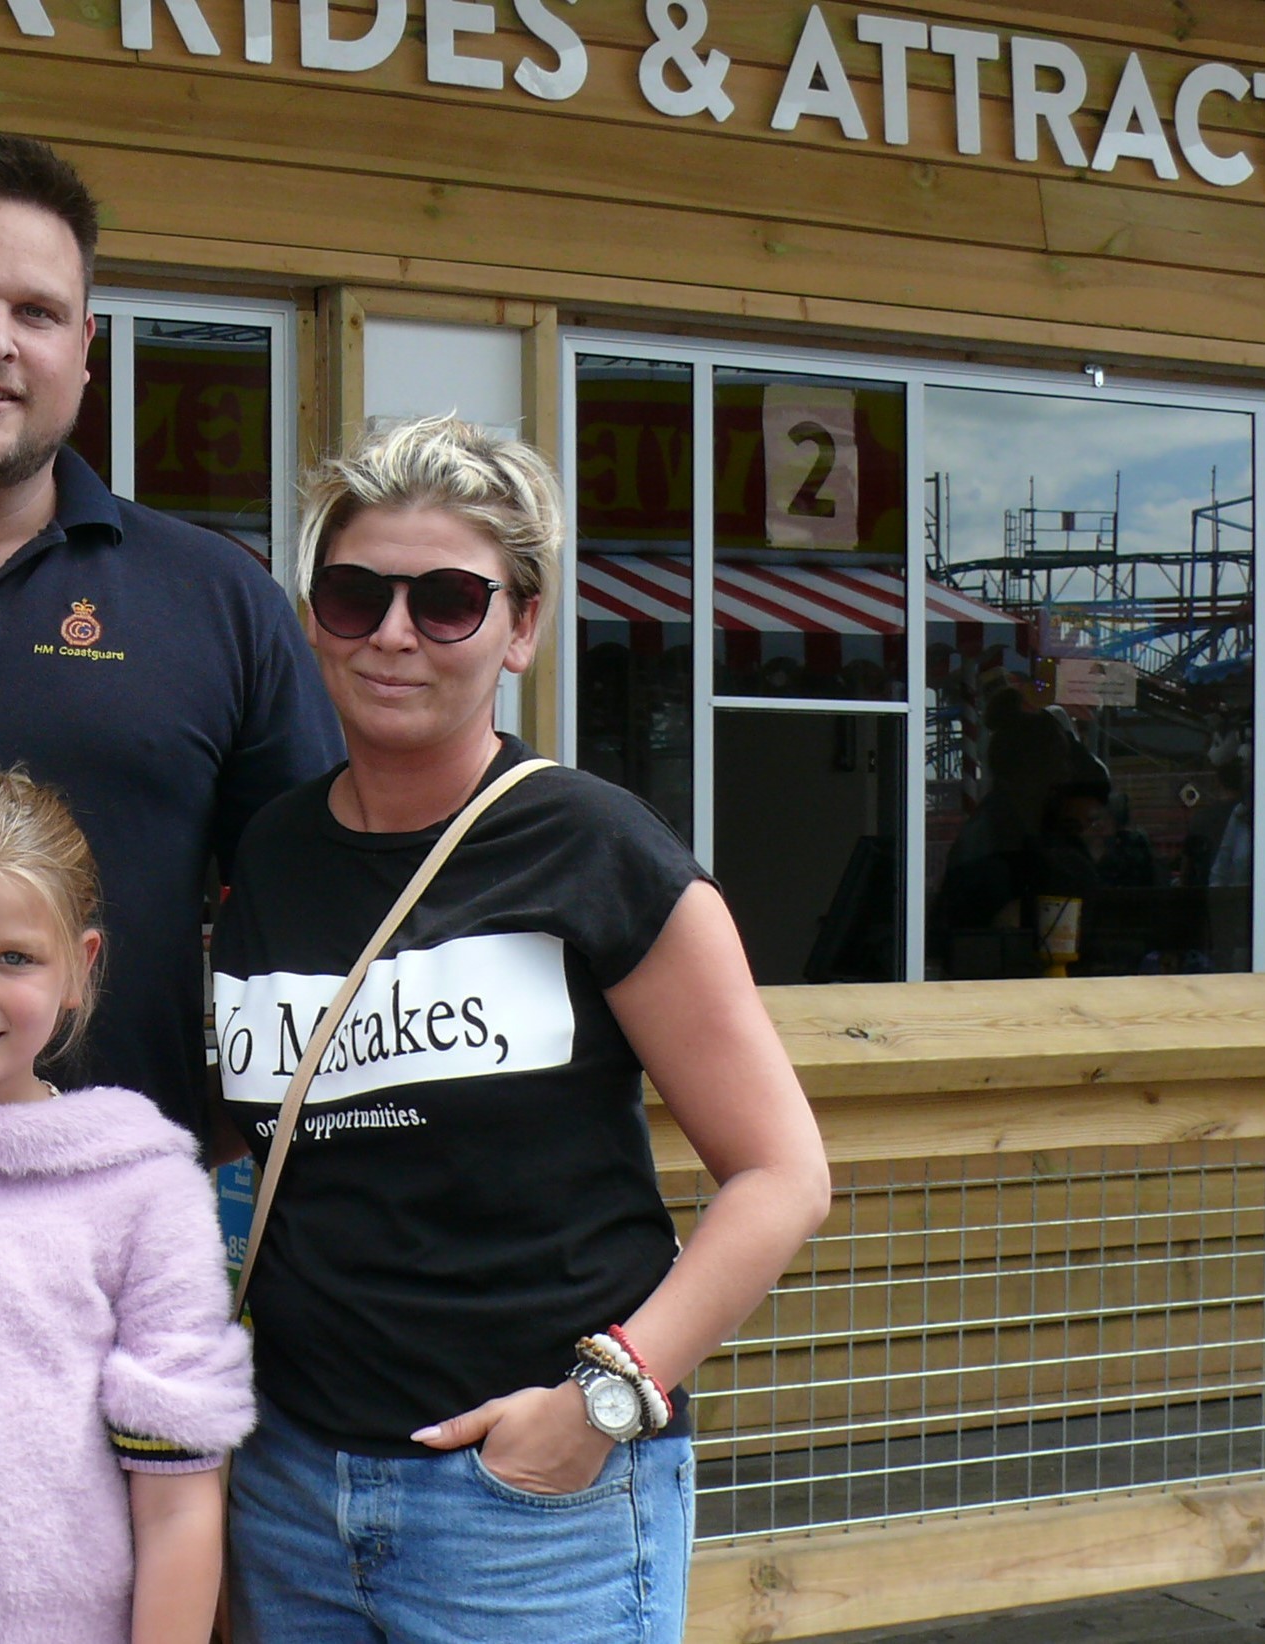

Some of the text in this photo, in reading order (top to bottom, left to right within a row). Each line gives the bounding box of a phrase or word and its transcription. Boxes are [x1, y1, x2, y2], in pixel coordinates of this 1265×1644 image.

[638, 0, 735, 123] &
[770, 4, 1265, 188] ATTRAC
[788, 420, 837, 518] 2
[34, 644, 124, 660] HM Coastguard
[272, 979, 509, 1076] Mstakes,
[255, 1102, 428, 1141] on opportunities.
